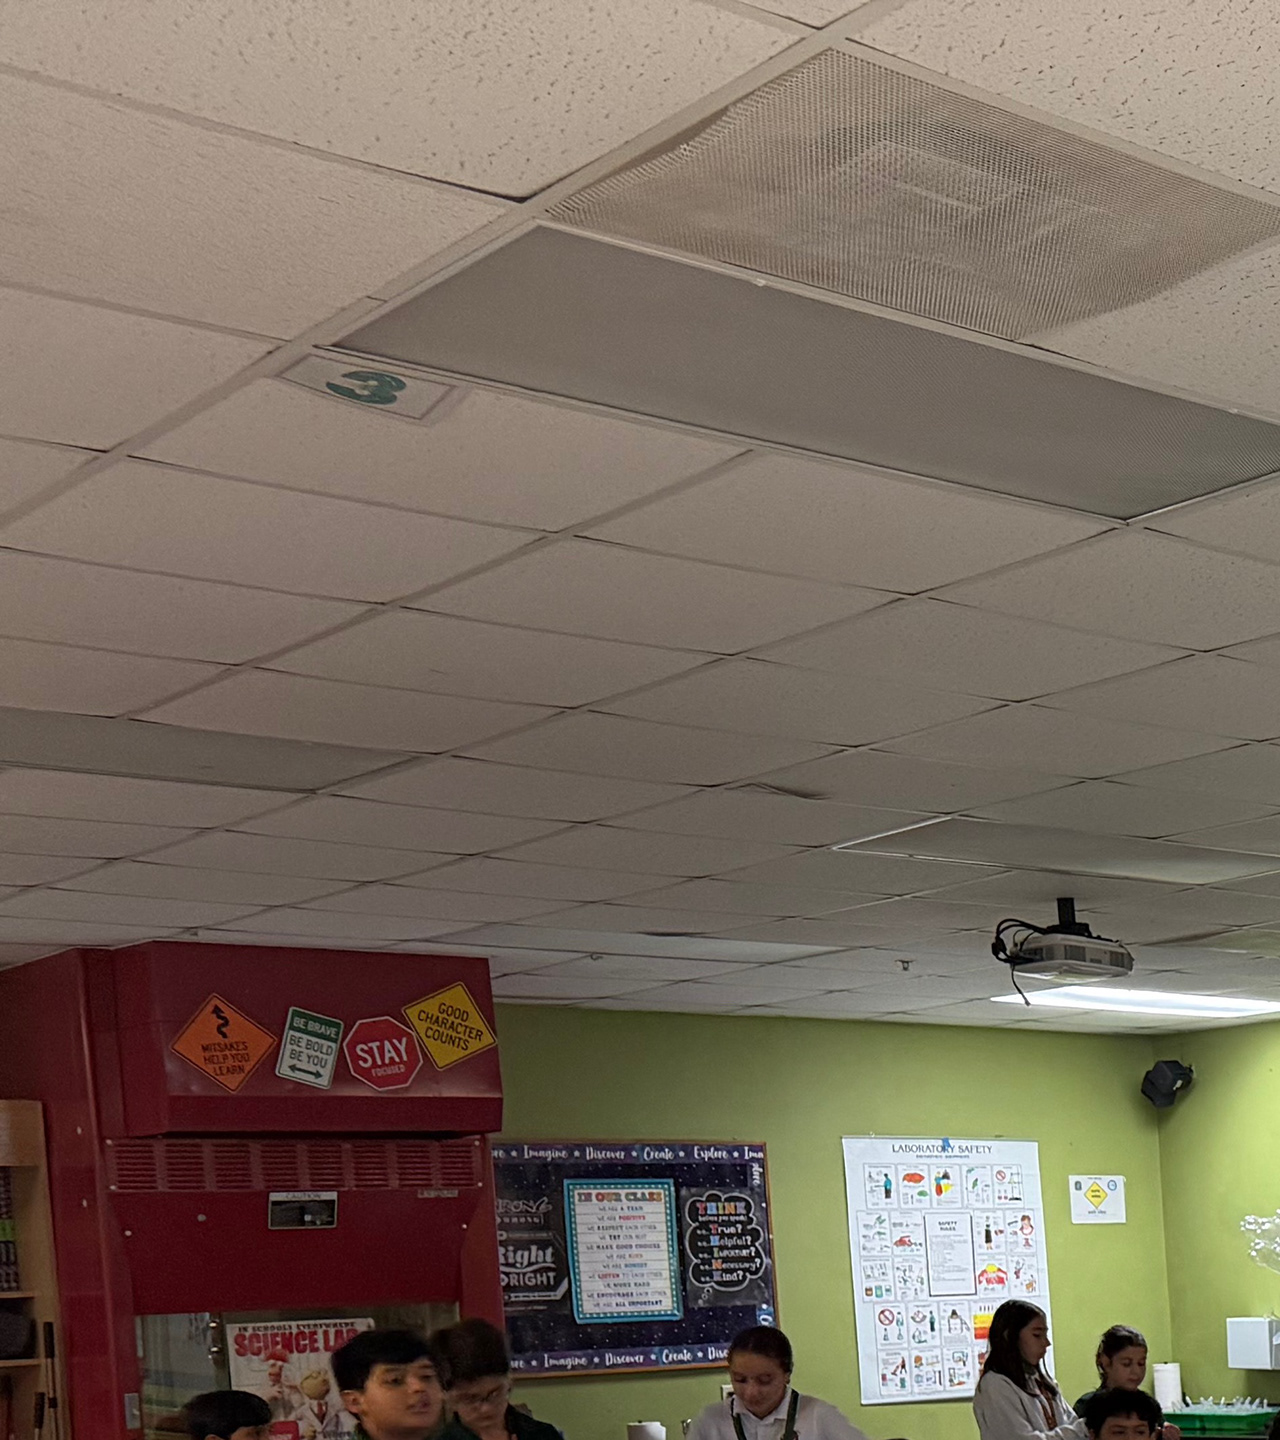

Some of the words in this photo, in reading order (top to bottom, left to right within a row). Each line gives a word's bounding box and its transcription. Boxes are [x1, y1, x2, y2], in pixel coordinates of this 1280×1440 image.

[437, 1001, 469, 1023] GOOD
[293, 1016, 308, 1030] BE
[307, 1021, 338, 1039] BRAVE
[417, 1009, 484, 1042] CHARACTER
[289, 1035, 304, 1048] BE
[305, 1039, 334, 1056] BOLD
[424, 1026, 470, 1051] COUNTS
[204, 1054, 226, 1066] HELP
[229, 1052, 250, 1064] YOU
[289, 1048, 304, 1061] BE
[306, 1053, 328, 1069] YOU
[355, 1037, 410, 1068] STAY
[213, 1063, 246, 1078] LEARN
[372, 1064, 405, 1077] FOCUSED
[524, 1145, 568, 1161] Imagine
[586, 1147, 625, 1160] Discover
[644, 1147, 675, 1161] Create
[694, 1146, 728, 1161] Explore
[695, 1202, 746, 1215] THINK
[711, 1235, 751, 1247] Helpful?
[713, 1272, 743, 1282] Kind?
[234, 1330, 320, 1357] SCIENCE
[544, 1354, 588, 1370] Imagine
[605, 1353, 644, 1366] Discover
[662, 1351, 693, 1364] Create
